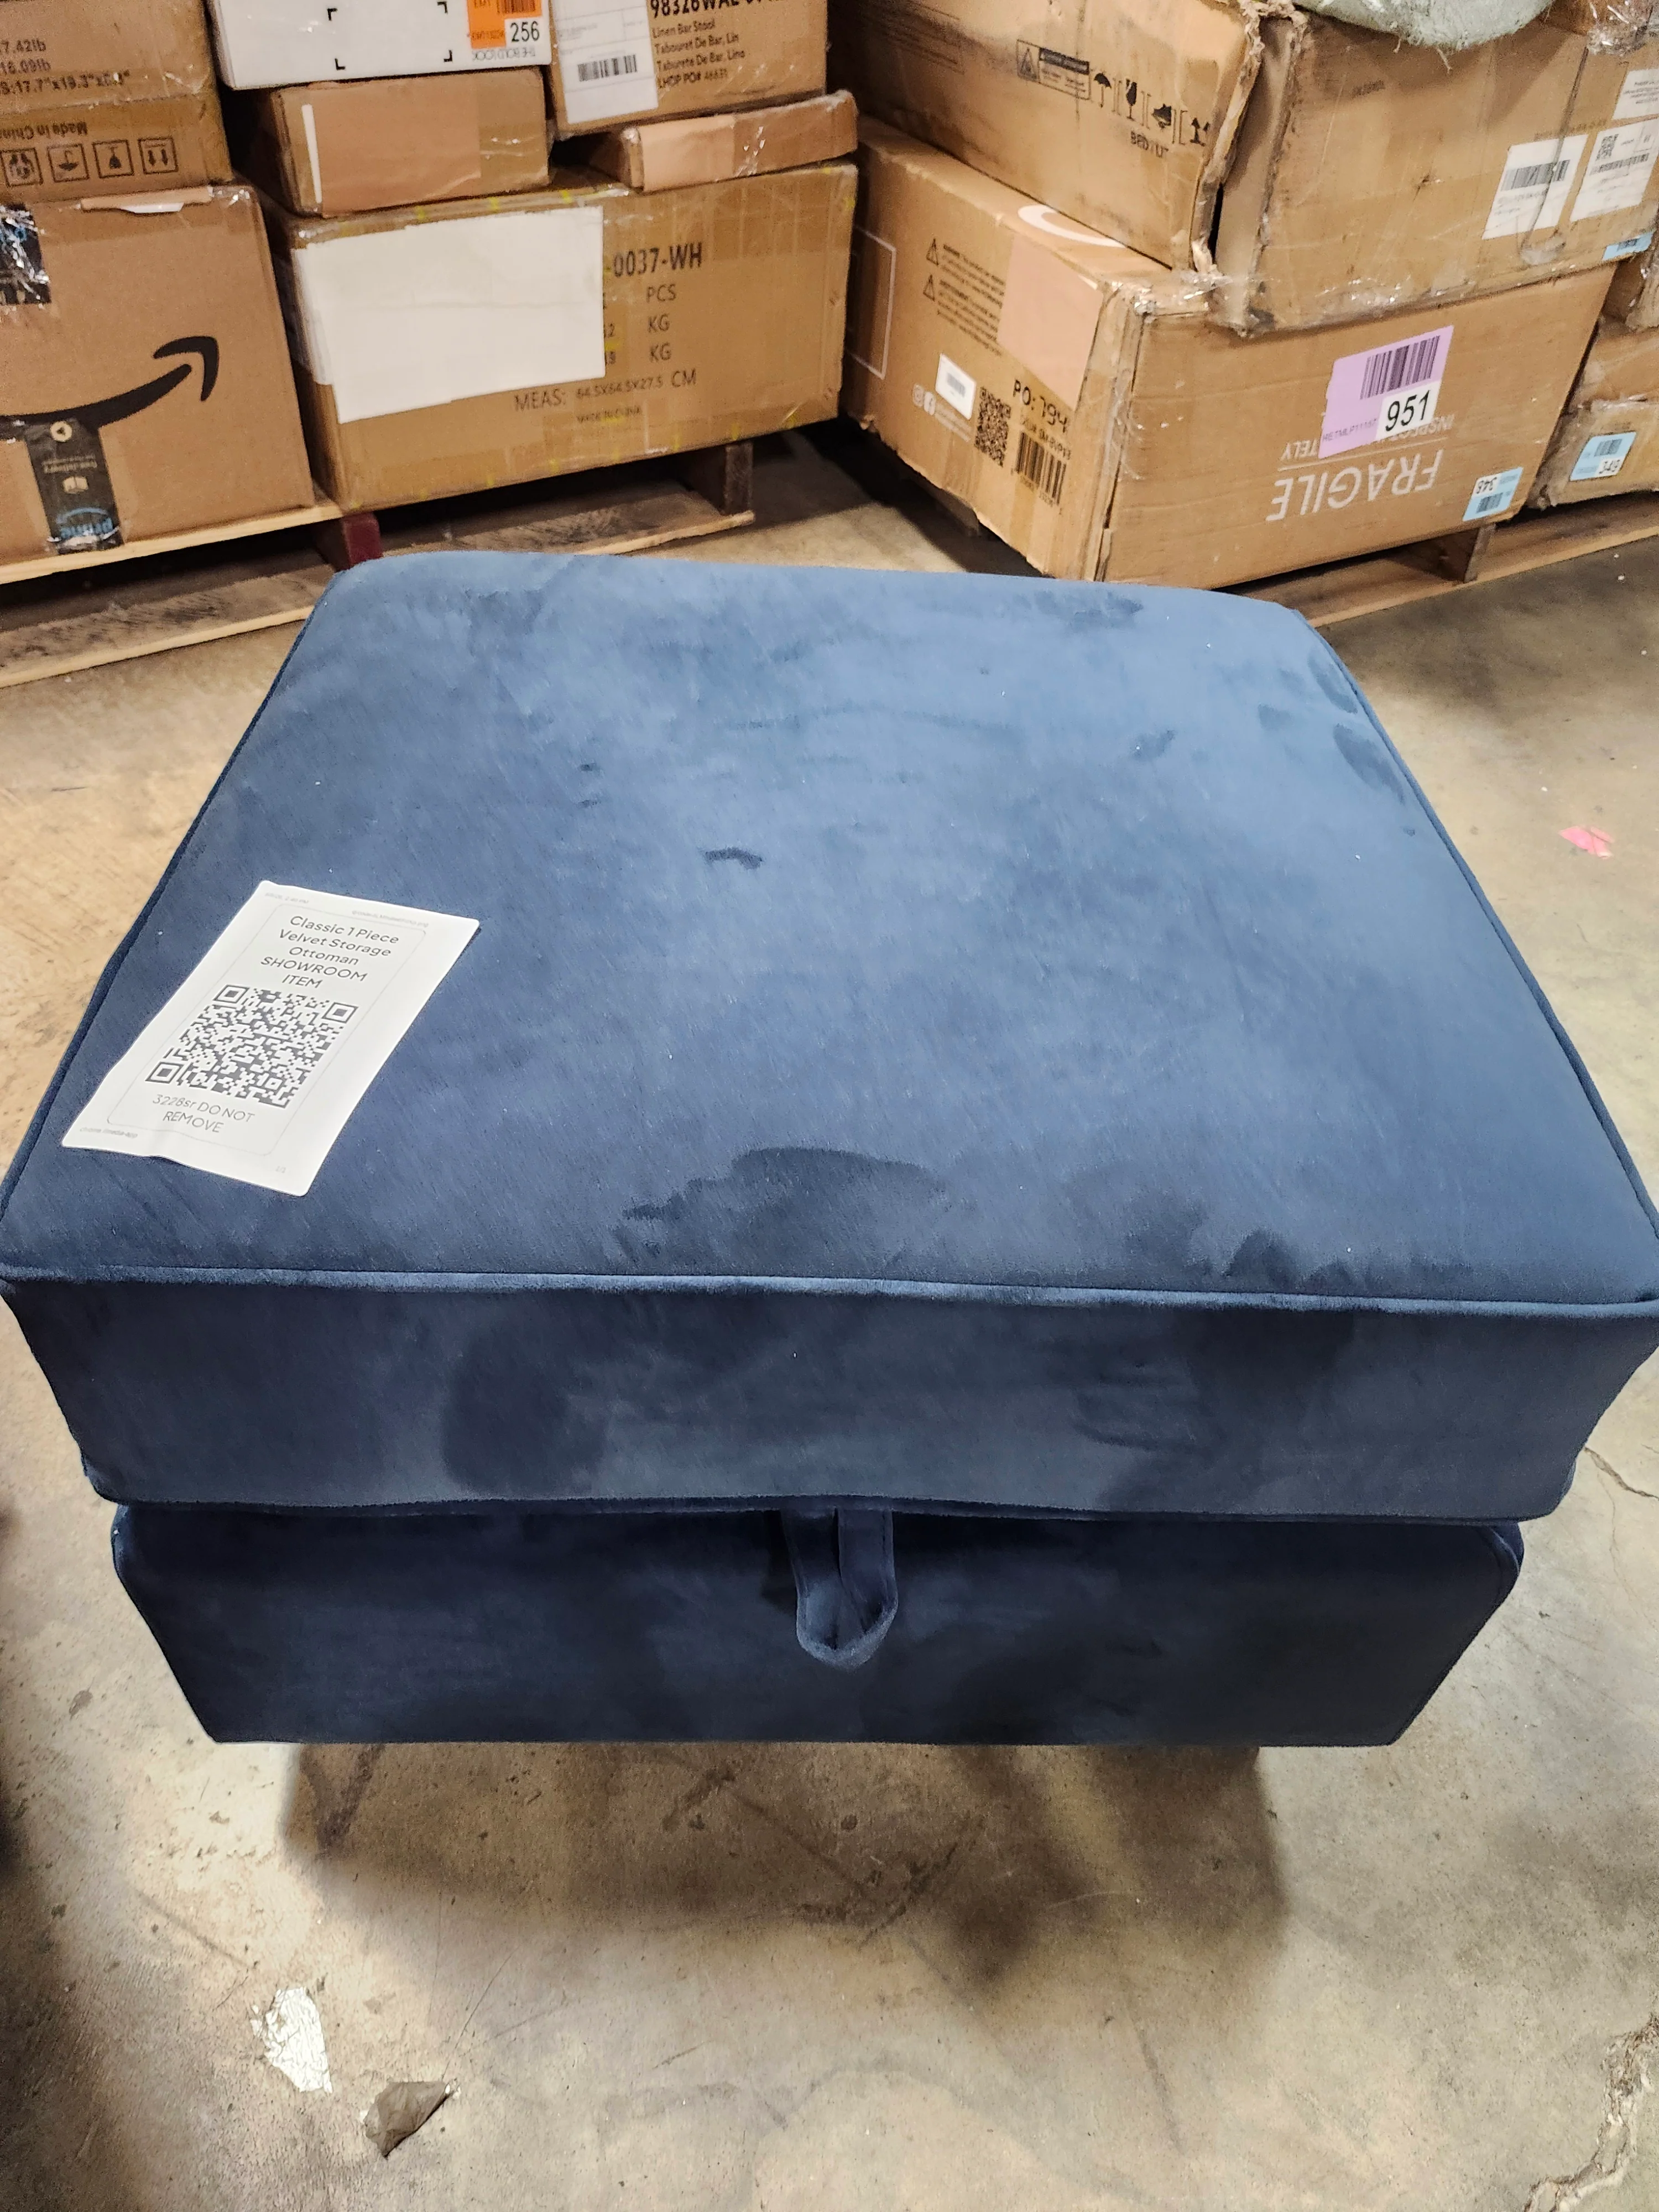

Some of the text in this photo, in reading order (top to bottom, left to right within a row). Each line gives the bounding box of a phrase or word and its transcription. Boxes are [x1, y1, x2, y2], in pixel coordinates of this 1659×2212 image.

[510, 20, 540, 42] 256
[677, 23, 692, 34] Bar
[0, 125, 34, 140] Chin
[52, 121, 88, 138] Made
[646, 283, 677, 302] PCS
[648, 312, 671, 333] KG
[649, 342, 672, 363] KG
[513, 388, 566, 412] MEAS:
[670, 367, 697, 388] CM
[1385, 389, 1432, 432] 951
[1265, 448, 1445, 521] FRAGILE
[290, 915, 345, 935] Classic
[347, 927, 356, 936] 1
[355, 928, 399, 944] Piece
[279, 928, 392, 957] Velvet Storage
[289, 946, 359, 966] Ottoman
[260, 956, 368, 982] SHOWROOM
[281, 974, 324, 989] ITEM
[162, 1110, 225, 1134] REMOVE
[196, 1101, 221, 1116] DO
[221, 1105, 255, 1123] NOT
